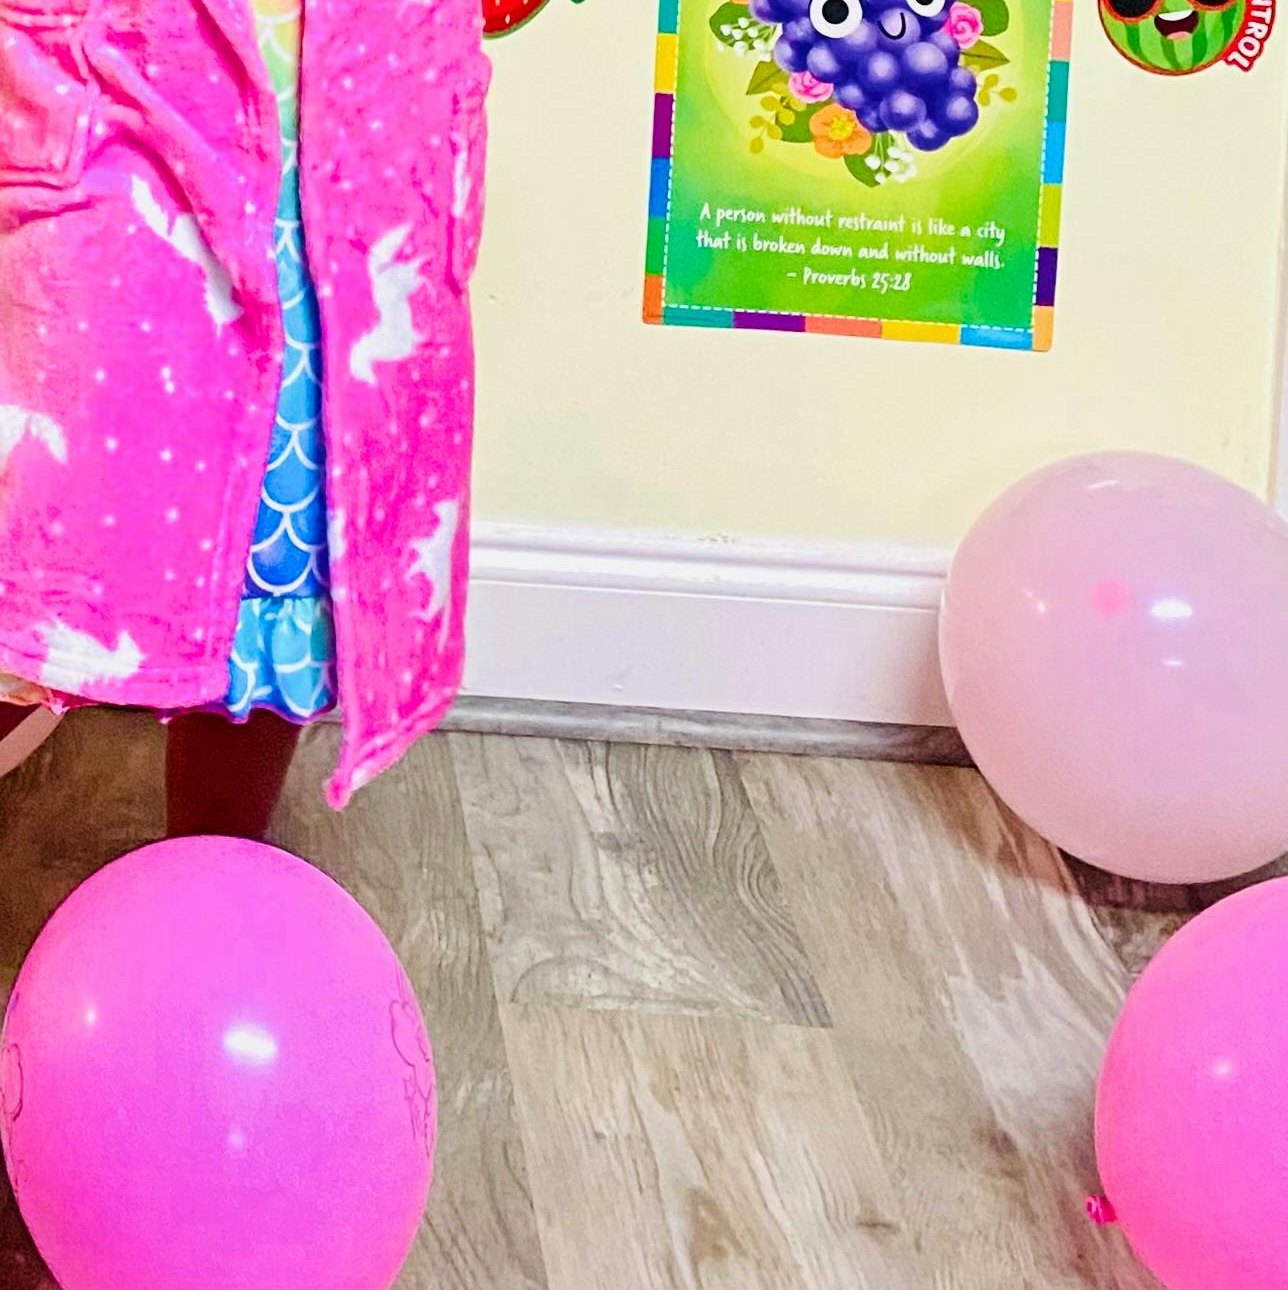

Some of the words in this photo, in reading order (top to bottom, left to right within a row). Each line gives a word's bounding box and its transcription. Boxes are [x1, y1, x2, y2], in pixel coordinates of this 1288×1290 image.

[700, 202, 711, 220] A
[715, 208, 765, 227] person
[771, 206, 833, 227] without
[837, 212, 906, 232] restraint
[911, 214, 923, 236] is
[927, 218, 955, 236] like
[959, 226, 971, 237] a
[976, 221, 1005, 248] city
